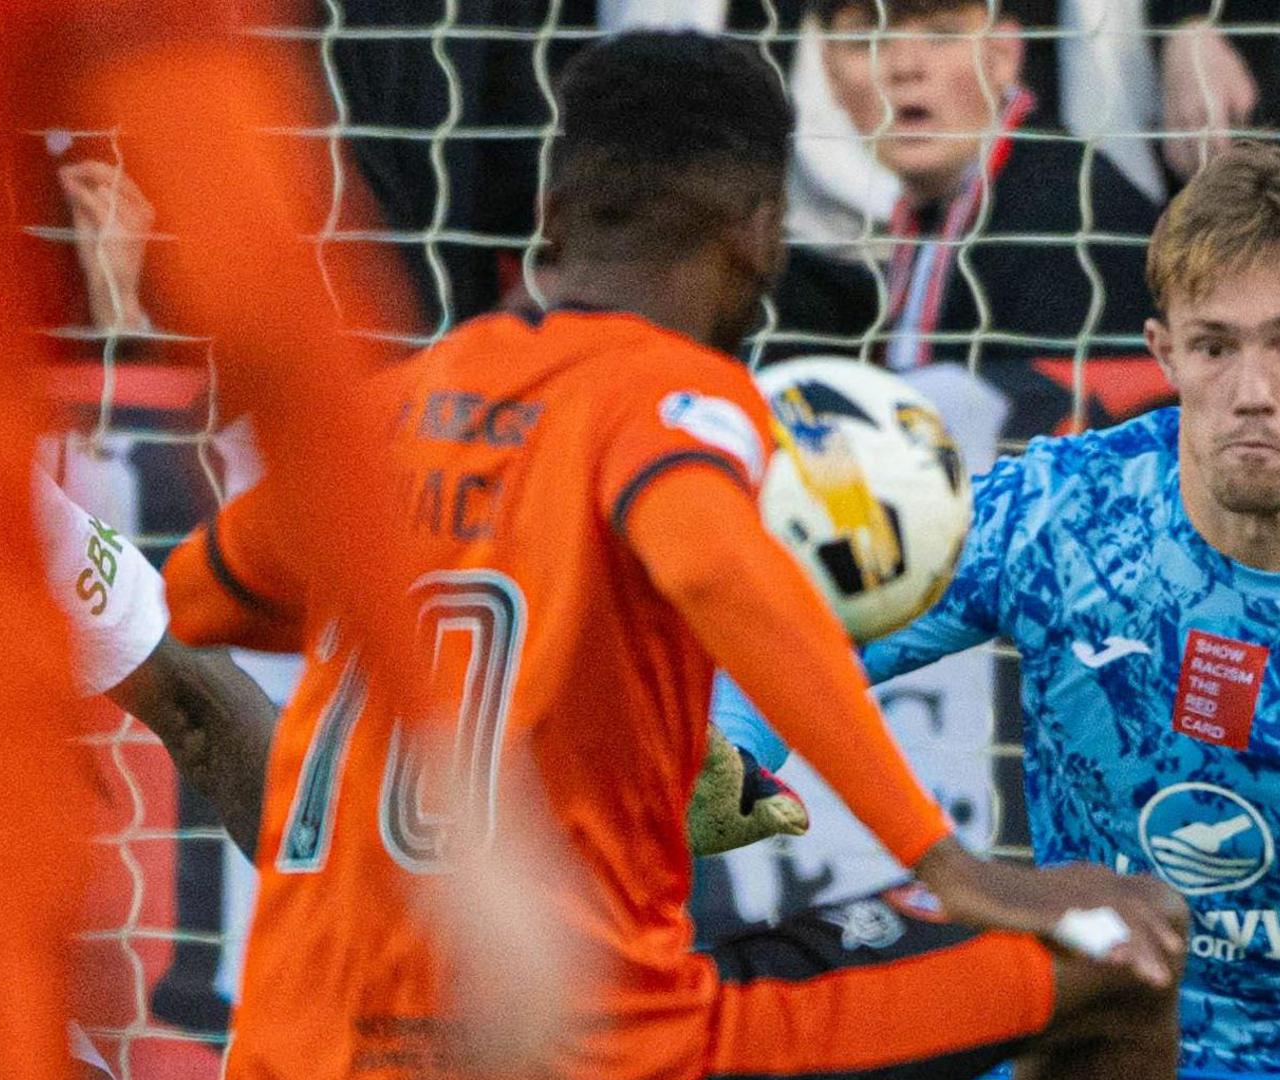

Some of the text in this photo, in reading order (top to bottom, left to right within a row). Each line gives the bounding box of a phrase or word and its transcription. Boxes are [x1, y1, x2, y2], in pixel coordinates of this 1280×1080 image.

[1195, 639, 1247, 663] SHOW
[1191, 656, 1255, 685] RACISM
[1188, 674, 1220, 696] THE
[1184, 692, 1218, 718] RED
[1181, 715, 1226, 739] CARD
